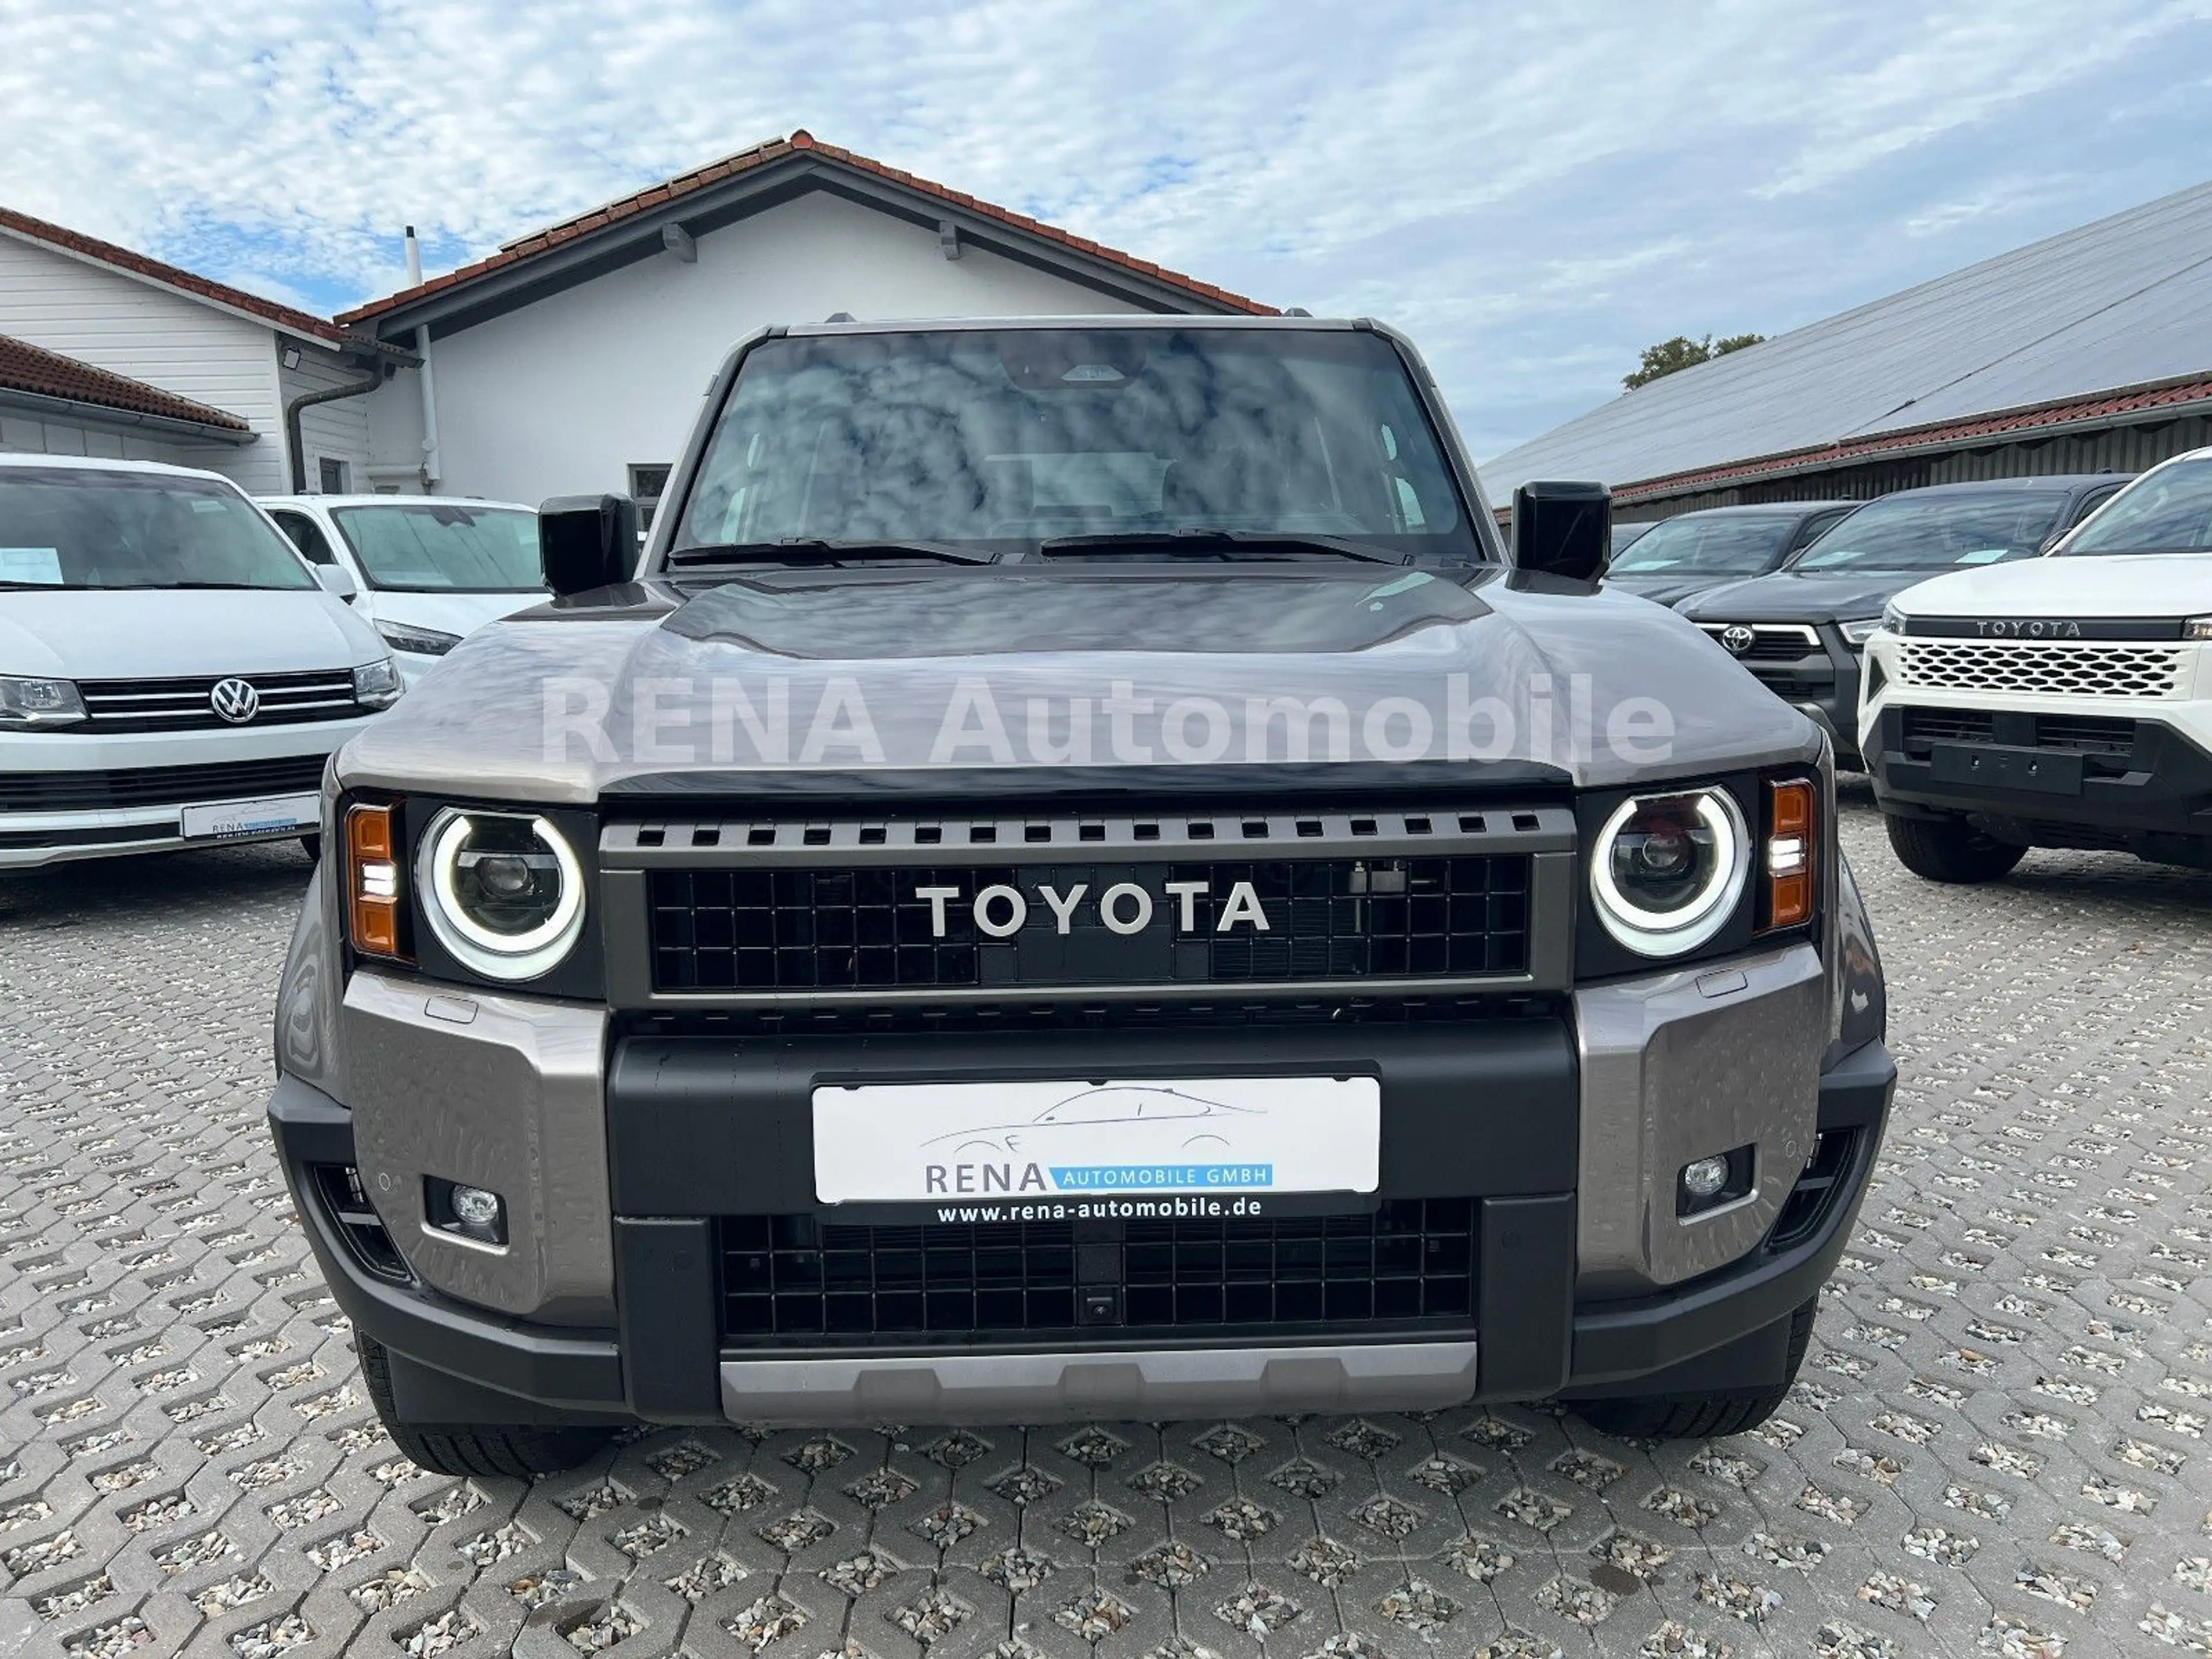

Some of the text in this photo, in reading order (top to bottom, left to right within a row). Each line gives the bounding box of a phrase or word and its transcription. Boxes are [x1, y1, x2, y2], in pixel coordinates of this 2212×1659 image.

[1976, 621, 2081, 636] TOYOTA
[213, 822, 244, 833] RENA
[915, 881, 1270, 937] TOYOTA
[926, 1162, 1266, 1193] RENA AUTOMOBILE GMBH
[937, 1196, 1262, 1222] www.rena-automobile.de
